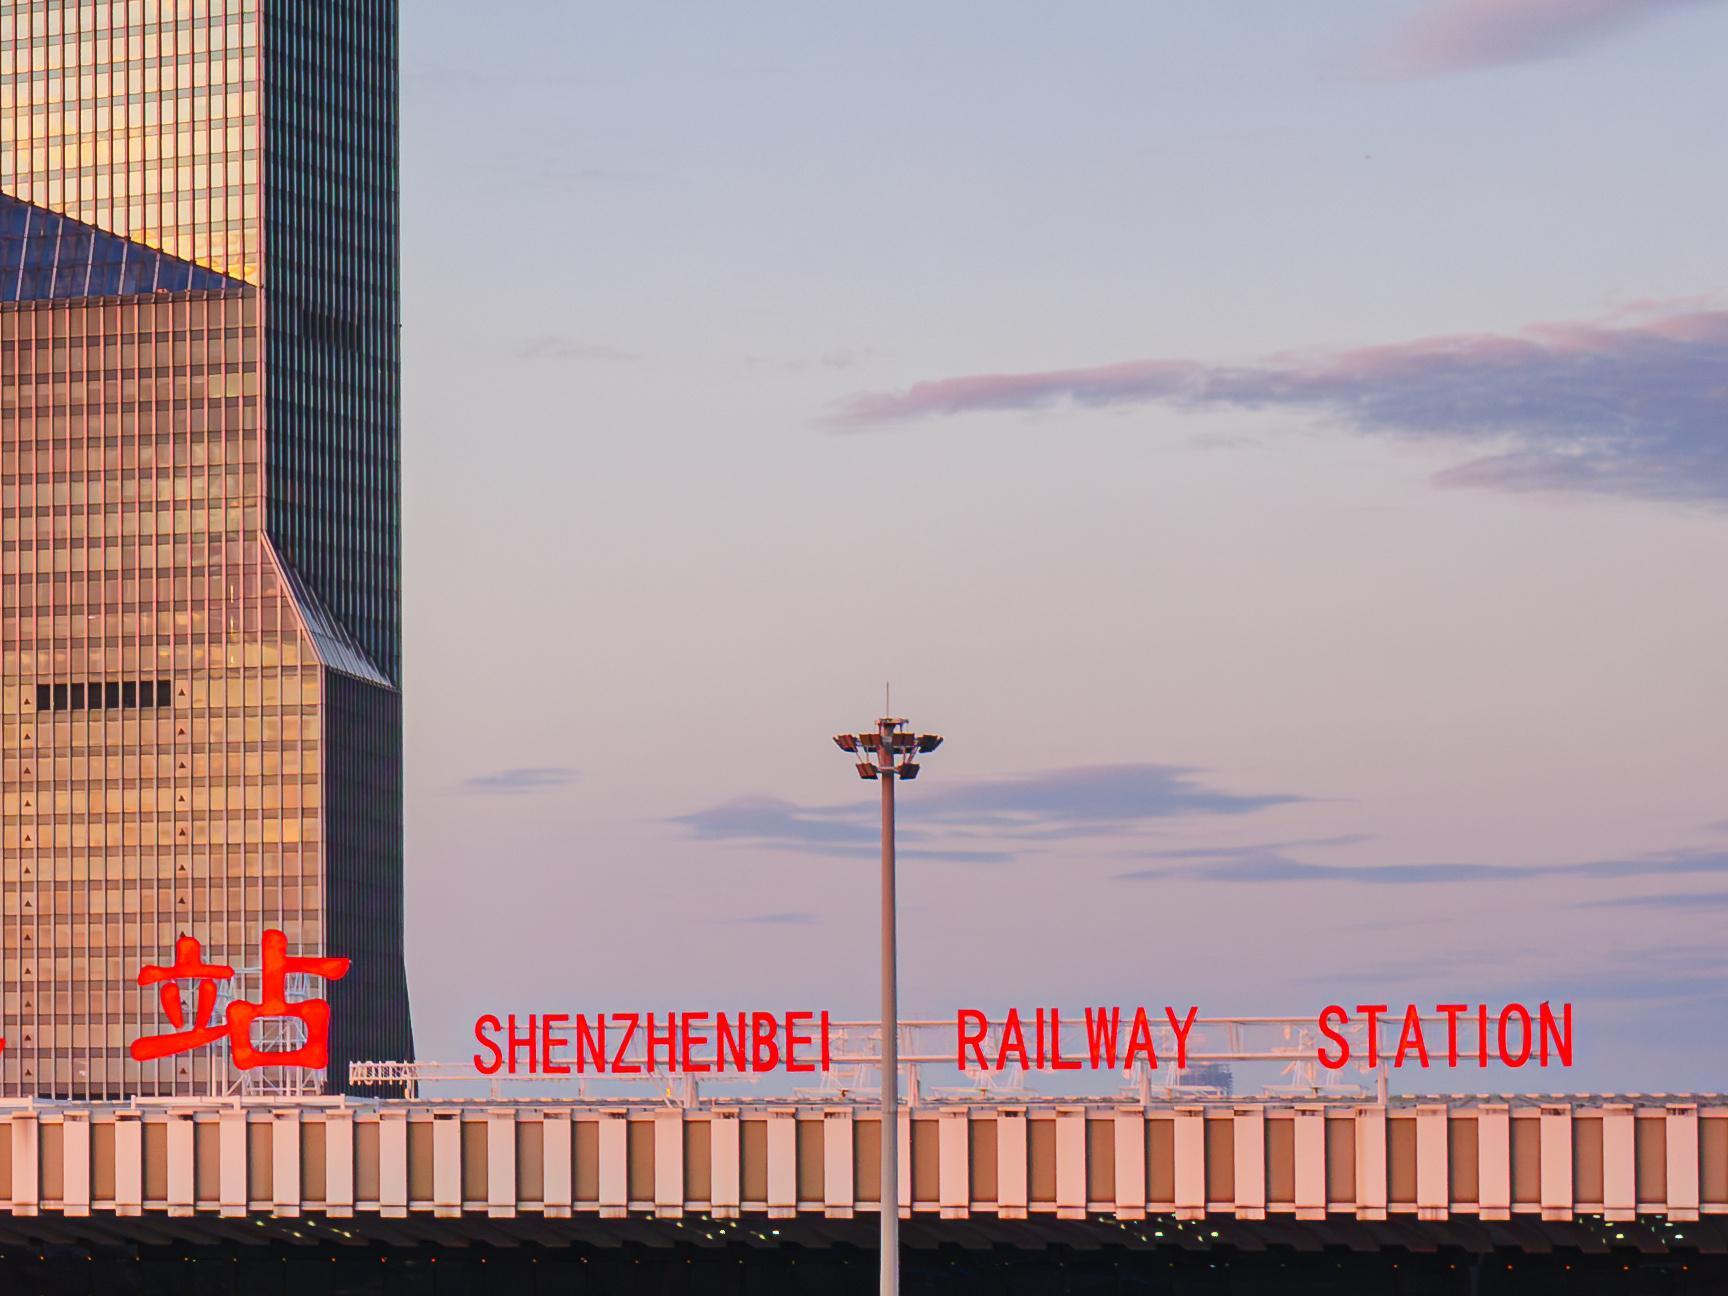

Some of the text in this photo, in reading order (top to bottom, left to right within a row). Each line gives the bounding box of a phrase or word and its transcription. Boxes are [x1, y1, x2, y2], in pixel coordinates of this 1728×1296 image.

[473, 1002, 1573, 1075] SHENZHENBEI RAILWAY STATION
